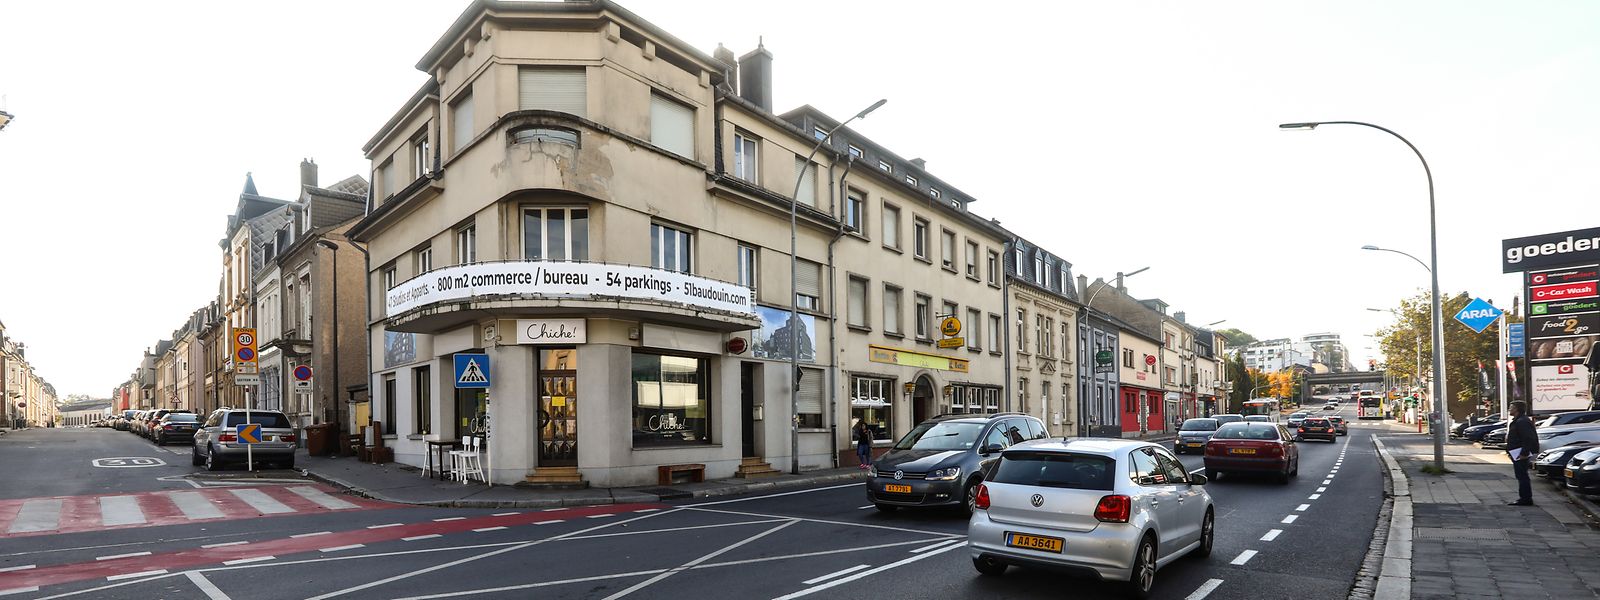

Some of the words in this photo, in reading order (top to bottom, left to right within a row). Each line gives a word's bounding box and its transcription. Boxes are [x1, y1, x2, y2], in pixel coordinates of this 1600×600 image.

[437, 276, 452, 292] 800
[454, 273, 469, 289] m2
[471, 272, 532, 287] commerce
[534, 267, 540, 286] /
[543, 269, 588, 285] bureau
[606, 272, 621, 287] 54
[624, 274, 672, 295] parkings
[684, 282, 747, 306] 51baudouin.com
[1567, 286, 1592, 294] Wash
[1460, 308, 1497, 320] ARAL
[526, 323, 577, 340] Chiche!
[1541, 320, 1567, 332] food
[1564, 318, 1578, 332] 2
[1573, 325, 1589, 335] go
[240, 335, 251, 343] 30
[1017, 536, 1030, 546] AA
[1031, 537, 1056, 550] 3641
